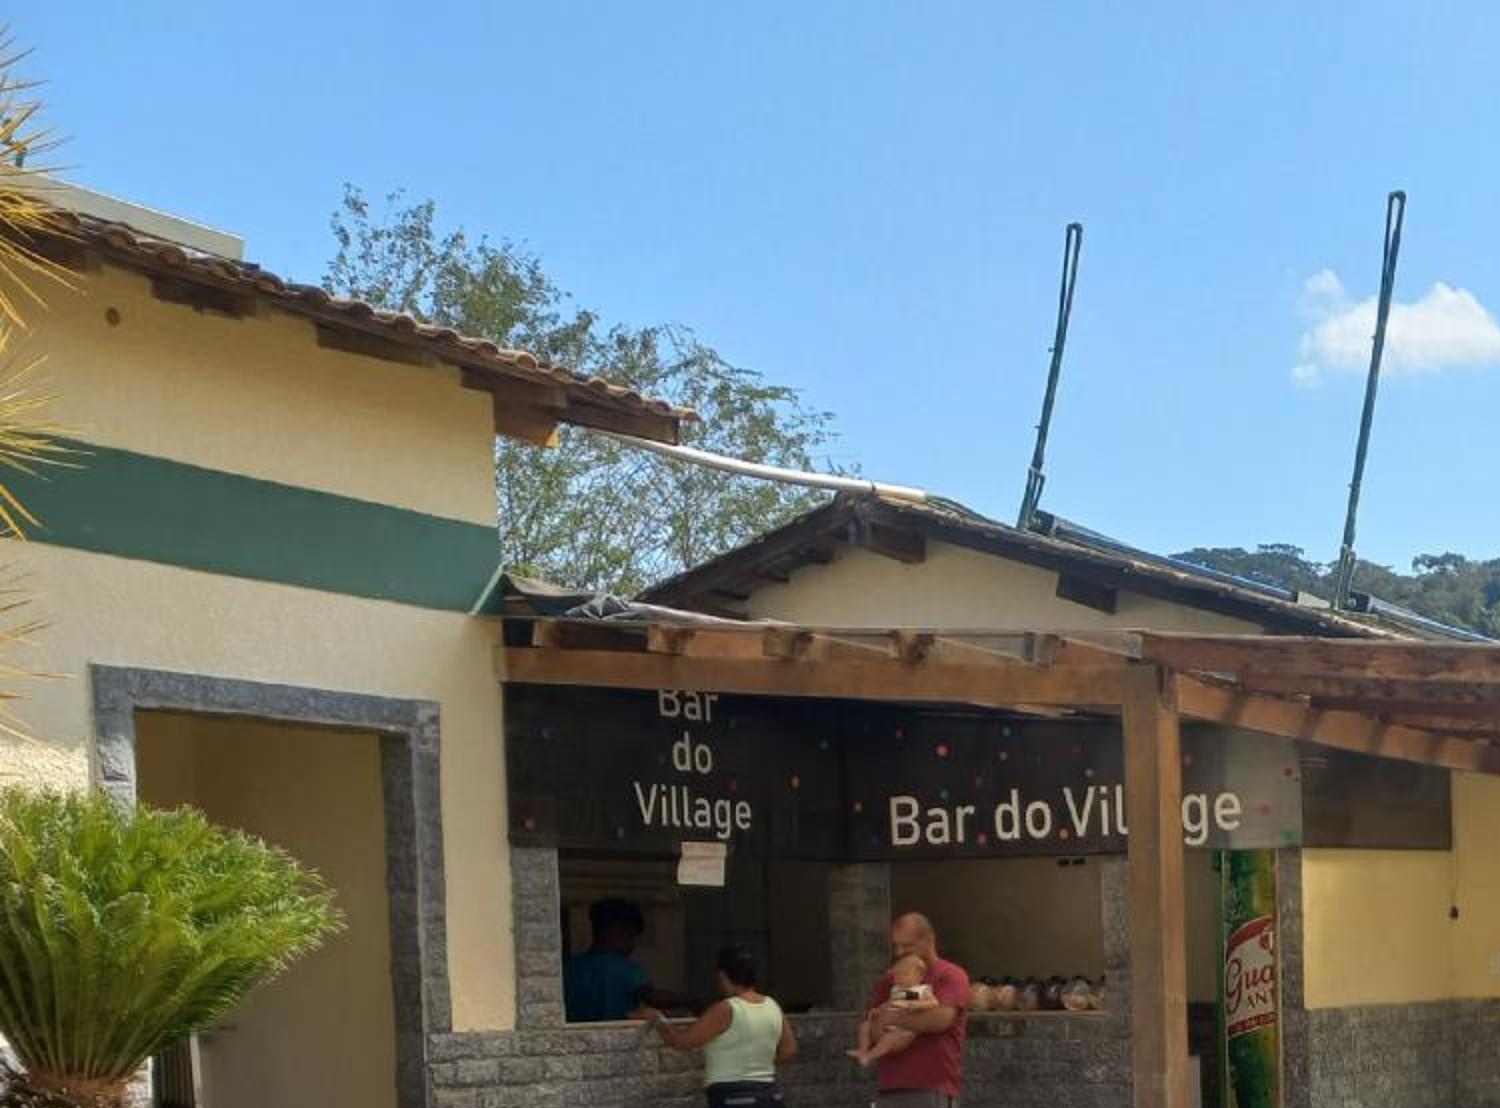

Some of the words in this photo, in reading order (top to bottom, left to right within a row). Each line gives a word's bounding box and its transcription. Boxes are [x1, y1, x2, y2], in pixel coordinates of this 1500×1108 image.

[657, 689, 719, 723] Bar
[672, 731, 713, 774] do
[633, 781, 752, 839] Village
[889, 796, 975, 846] Bar
[994, 788, 1051, 840] do
[1063, 784, 1242, 846] Vilge
